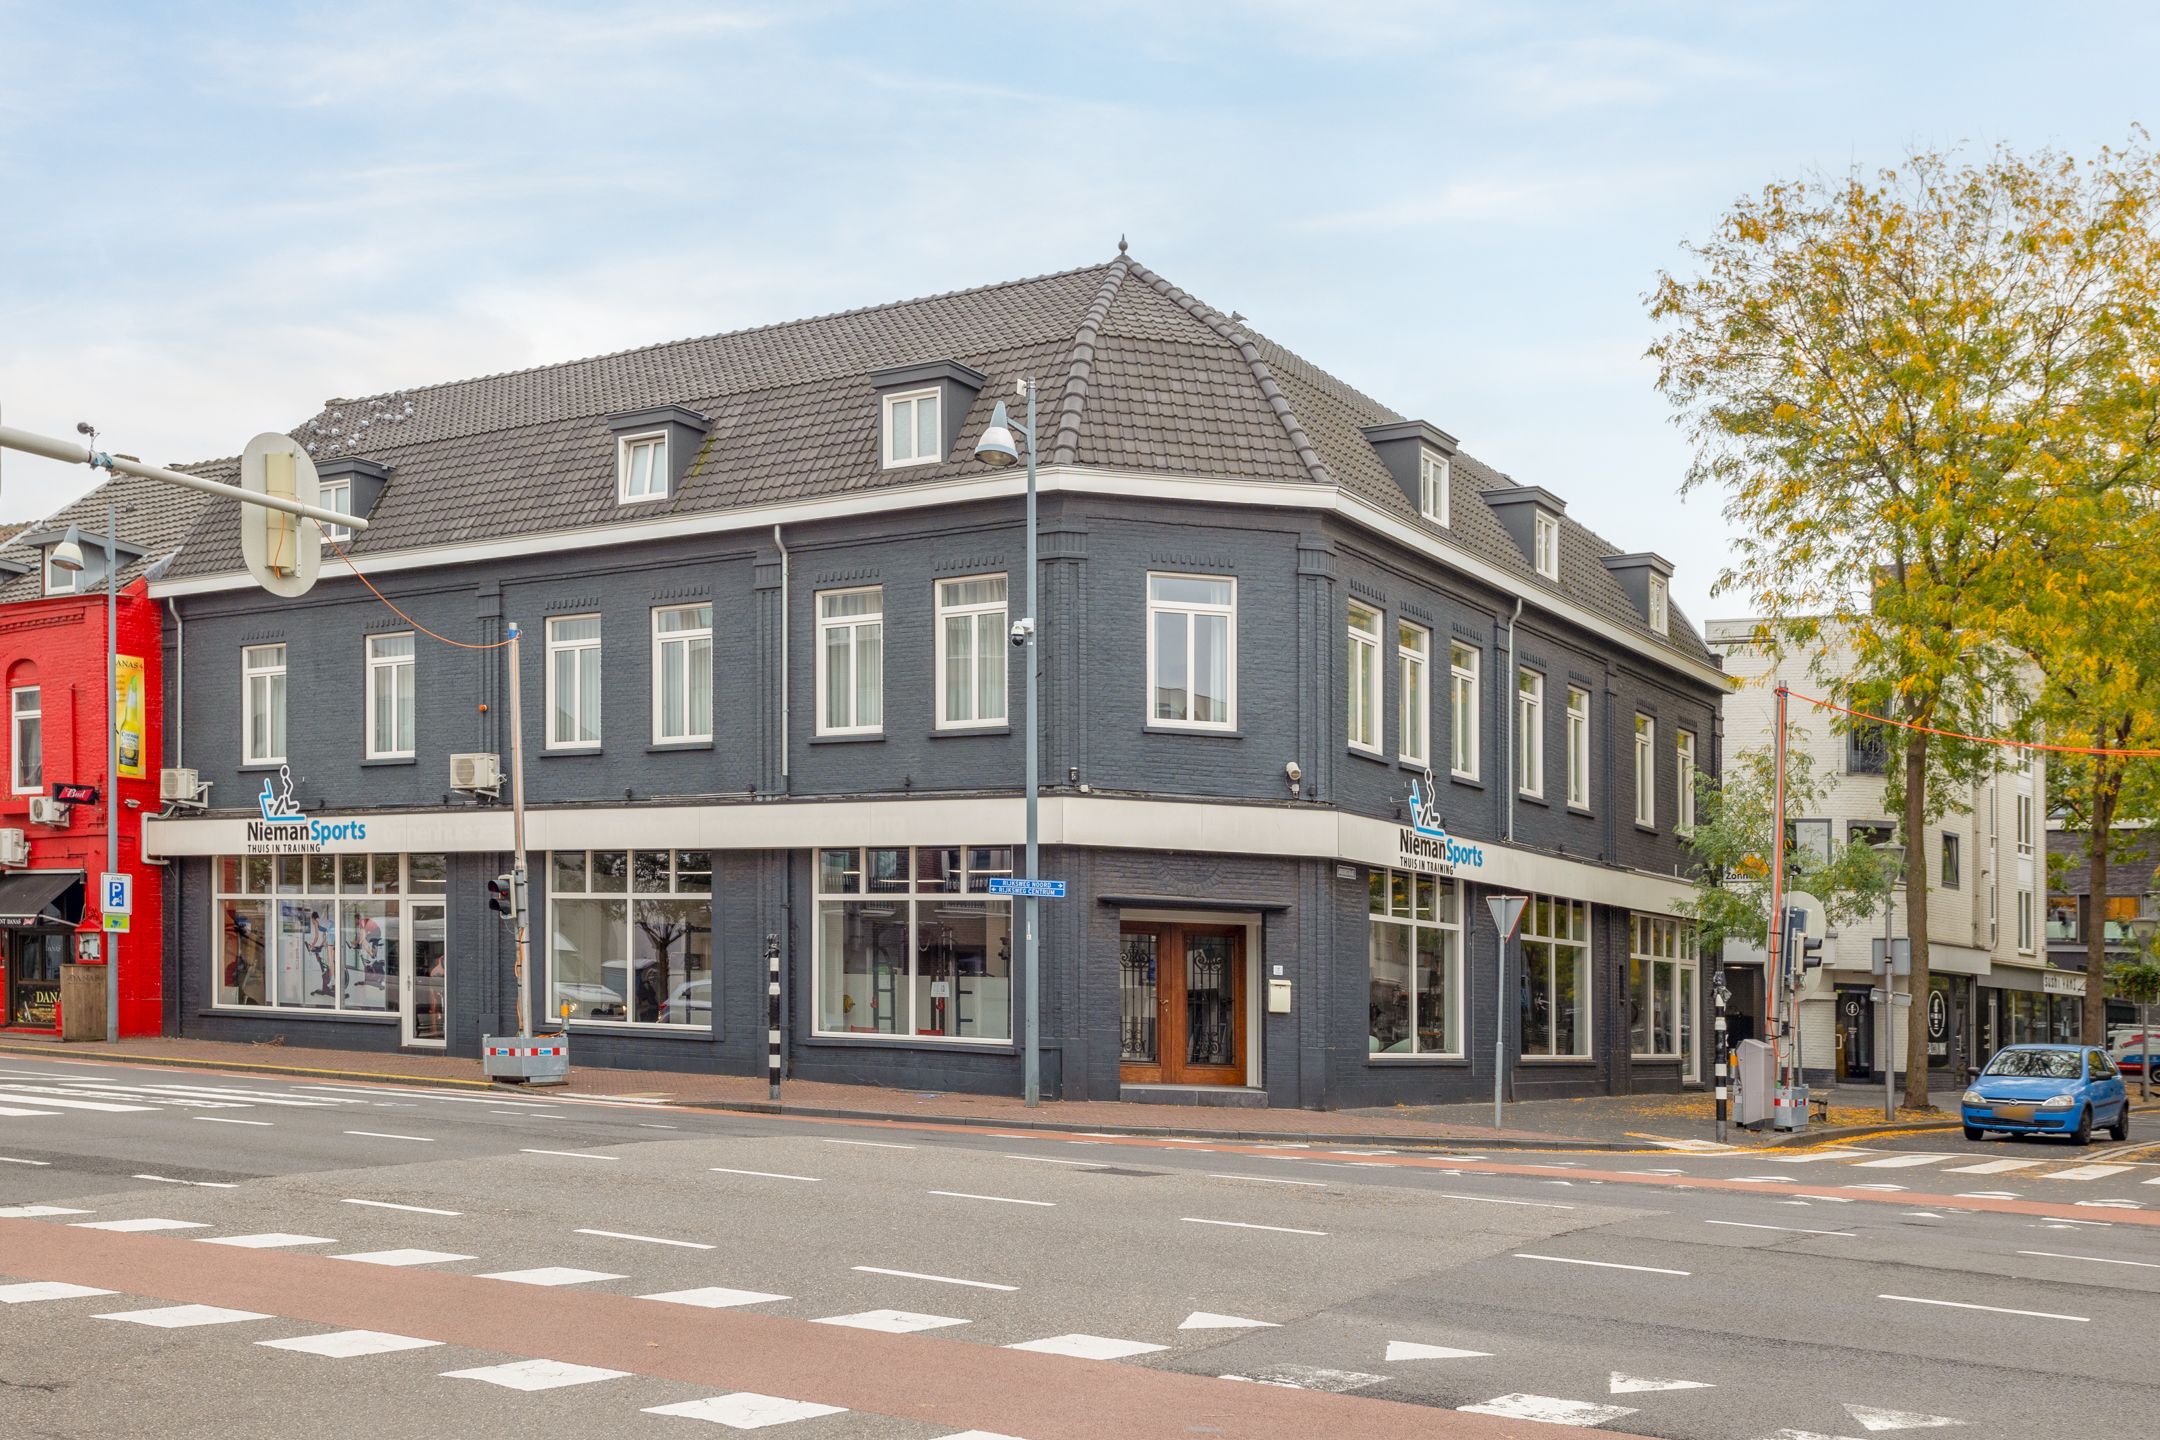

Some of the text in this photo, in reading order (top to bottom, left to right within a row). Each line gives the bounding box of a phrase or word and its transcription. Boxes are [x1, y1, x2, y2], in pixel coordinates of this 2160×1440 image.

[115, 660, 139, 669] ANAS
[67, 788, 86, 798] Bud
[247, 820, 366, 846] NiemanSports
[248, 843, 321, 853] THUIS IN TRAINING
[1400, 828, 1483, 869] NiemanSports
[1400, 856, 1454, 875] THUIS IN TRAINING
[1726, 872, 1748, 880] Zonn
[1002, 880, 1031, 888] RIJKSWEG
[112, 883, 122, 897] P
[998, 886, 1027, 894] RIJKSWEG
[36, 991, 62, 1003] DANA
